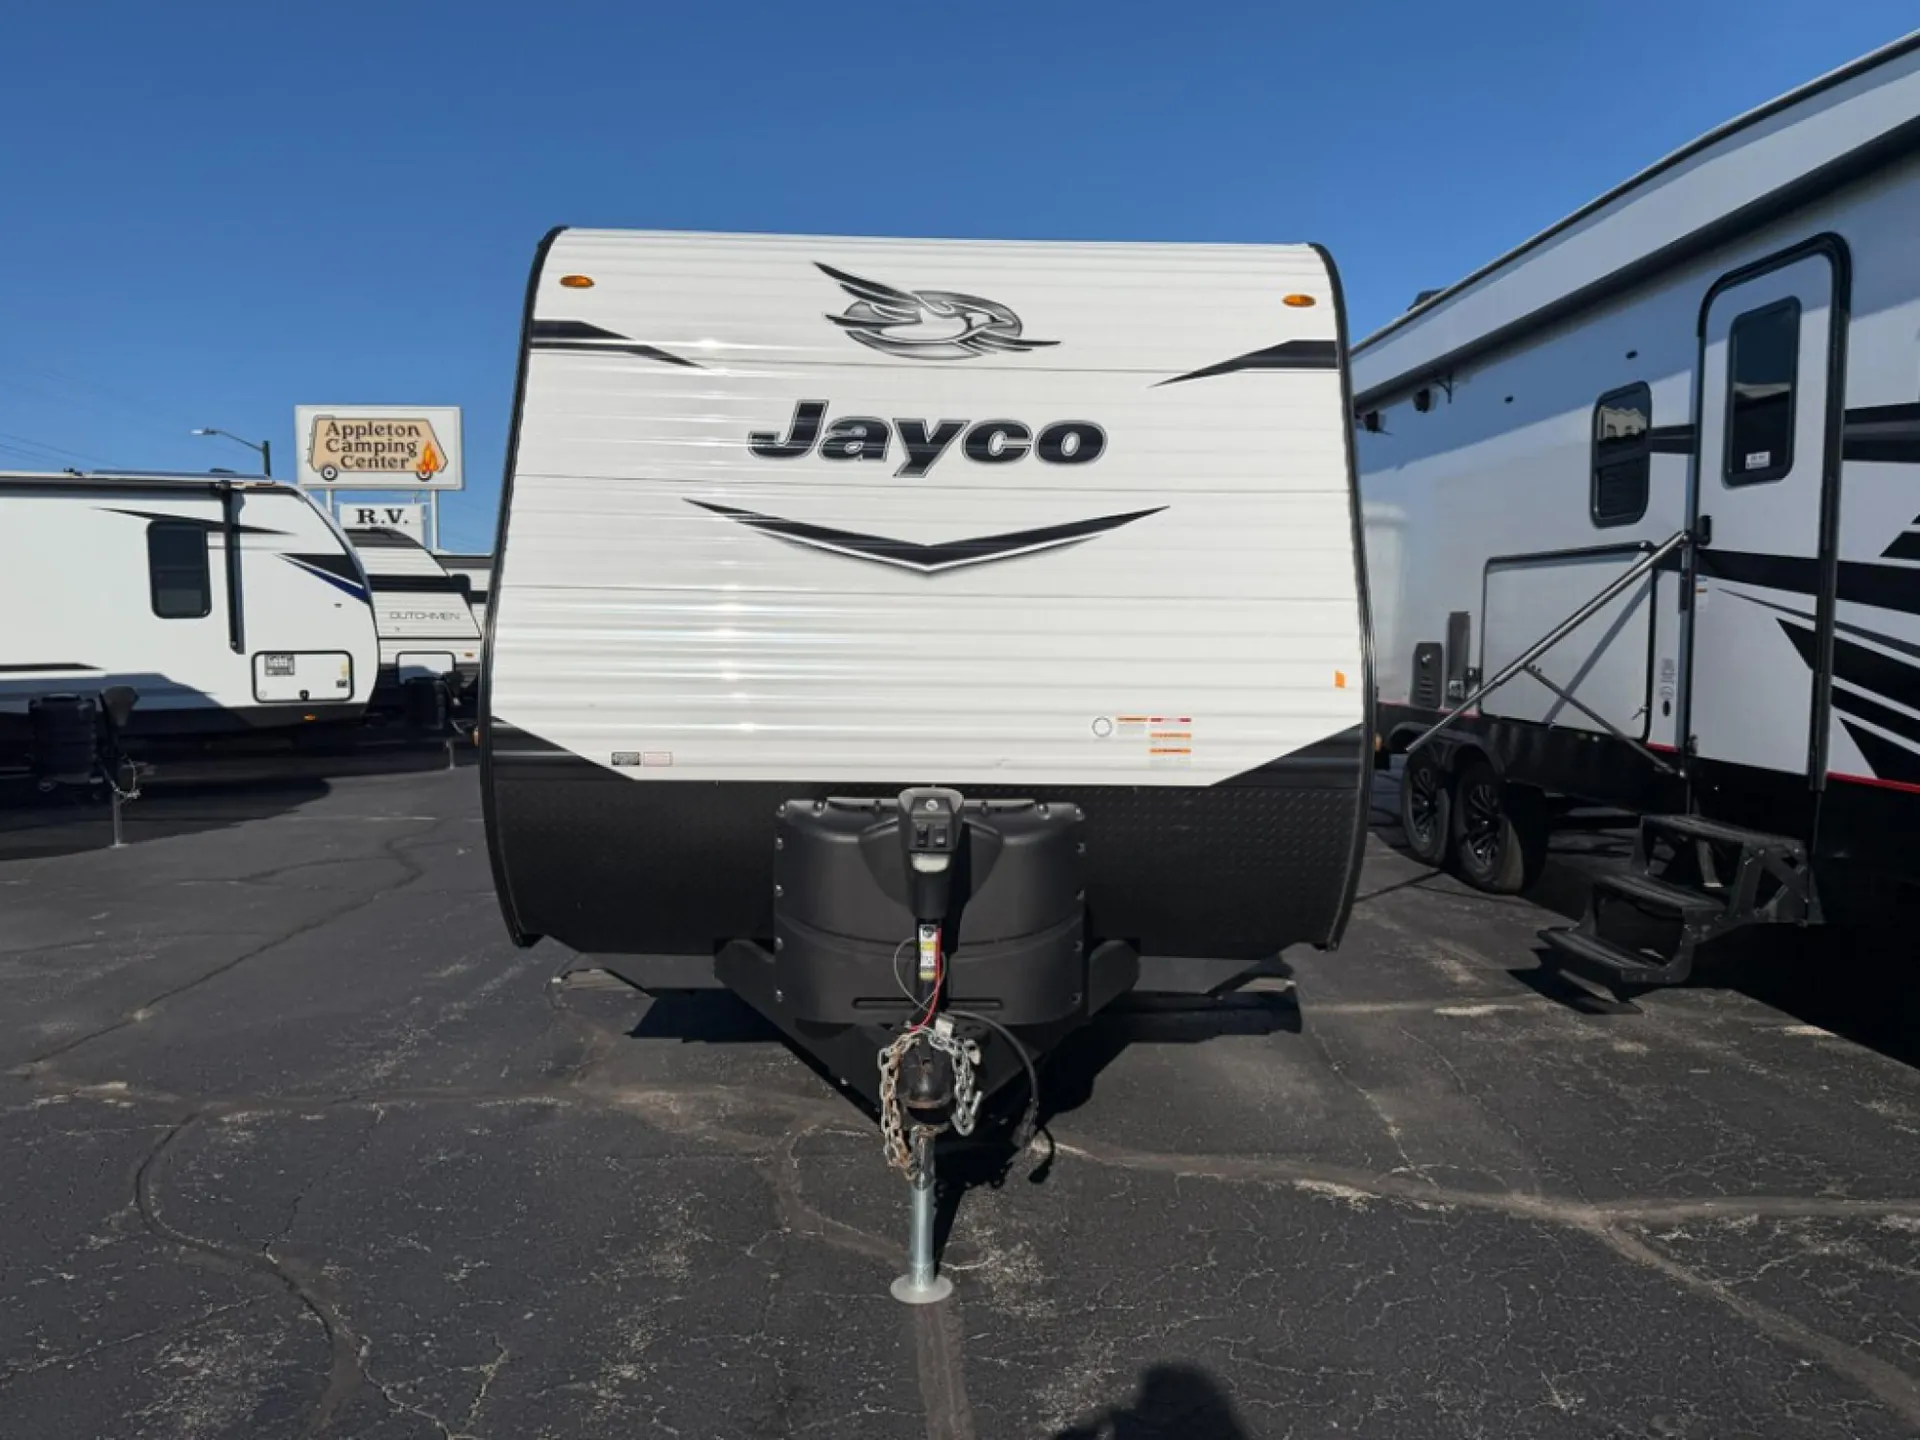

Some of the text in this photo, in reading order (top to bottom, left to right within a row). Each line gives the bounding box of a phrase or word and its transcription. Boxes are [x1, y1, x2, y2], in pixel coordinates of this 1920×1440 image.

[325, 421, 422, 440] Appleton
[747, 399, 1109, 479] Jayco
[325, 438, 419, 458] Camping
[340, 455, 410, 470] Center
[356, 508, 409, 525] R.V.
